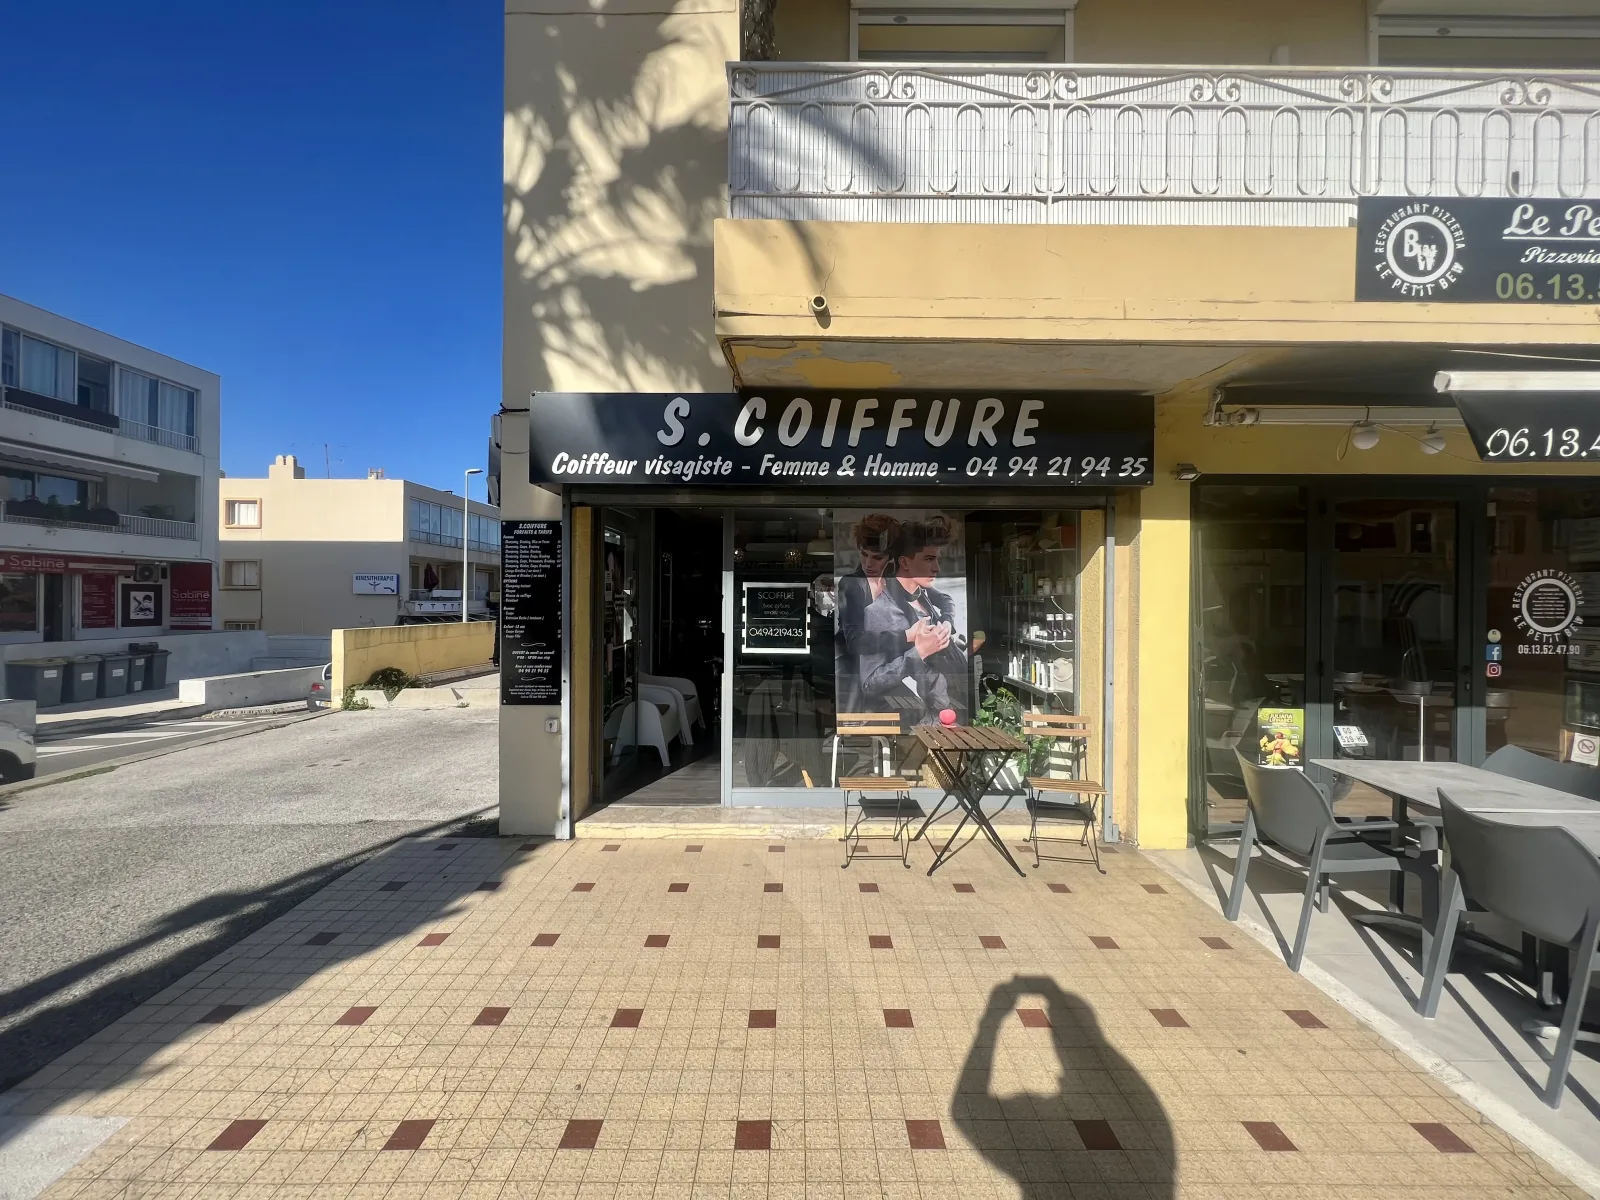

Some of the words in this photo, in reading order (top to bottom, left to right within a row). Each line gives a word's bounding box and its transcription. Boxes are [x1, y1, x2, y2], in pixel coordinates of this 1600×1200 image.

[1374, 203, 1430, 253] RESTAURANT
[1502, 204, 1550, 235] Le
[1375, 262, 1393, 279] LE
[1438, 262, 1464, 290] BEW
[1496, 272, 1600, 300] 06.13.
[656, 396, 710, 446] S.
[734, 396, 1044, 448] COIFFURE
[551, 452, 638, 475] Coiffeur
[644, 454, 732, 482] visagiste
[759, 454, 830, 476] Femme
[837, 454, 856, 476] &
[864, 452, 938, 476] Homme
[966, 456, 998, 476] 04
[1008, 456, 1038, 476] 94
[1047, 456, 1070, 476] 21
[1081, 456, 1112, 477] 94
[1118, 457, 1148, 477] 35
[9, 554, 65, 568] Sabine
[172, 588, 210, 599] Sabine
[1512, 569, 1555, 608] RESTAURANT
[1514, 615, 1526, 629] LE
[1564, 616, 1584, 637] BEW
